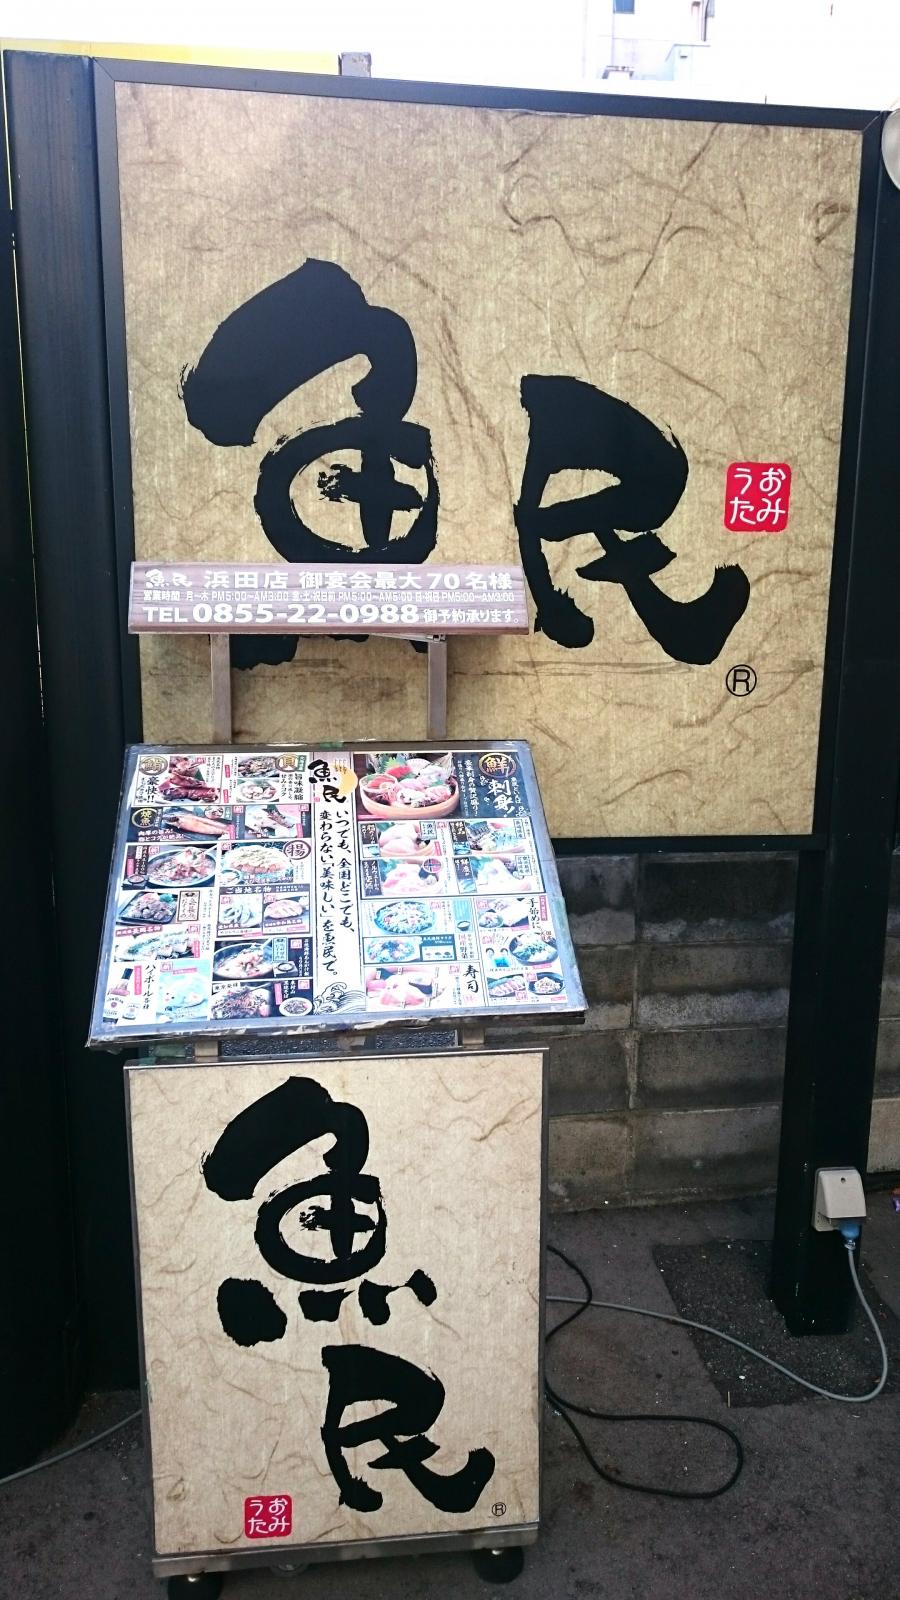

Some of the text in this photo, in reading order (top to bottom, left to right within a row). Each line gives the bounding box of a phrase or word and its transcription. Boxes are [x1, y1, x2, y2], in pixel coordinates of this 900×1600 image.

[178, 257, 750, 665] 魚民
[145, 569, 192, 588] 魚民
[204, 571, 289, 589] 浜田店
[143, 590, 180, 601] 営業時間
[142, 603, 519, 624] TEL 0855-22-0988 御予約承ります。
[485, 755, 512, 774] 鮮
[308, 759, 347, 803] 魚民
[286, 843, 307, 858] 揚
[463, 964, 480, 993] 寿司
[202, 1076, 495, 1513] 魚民
